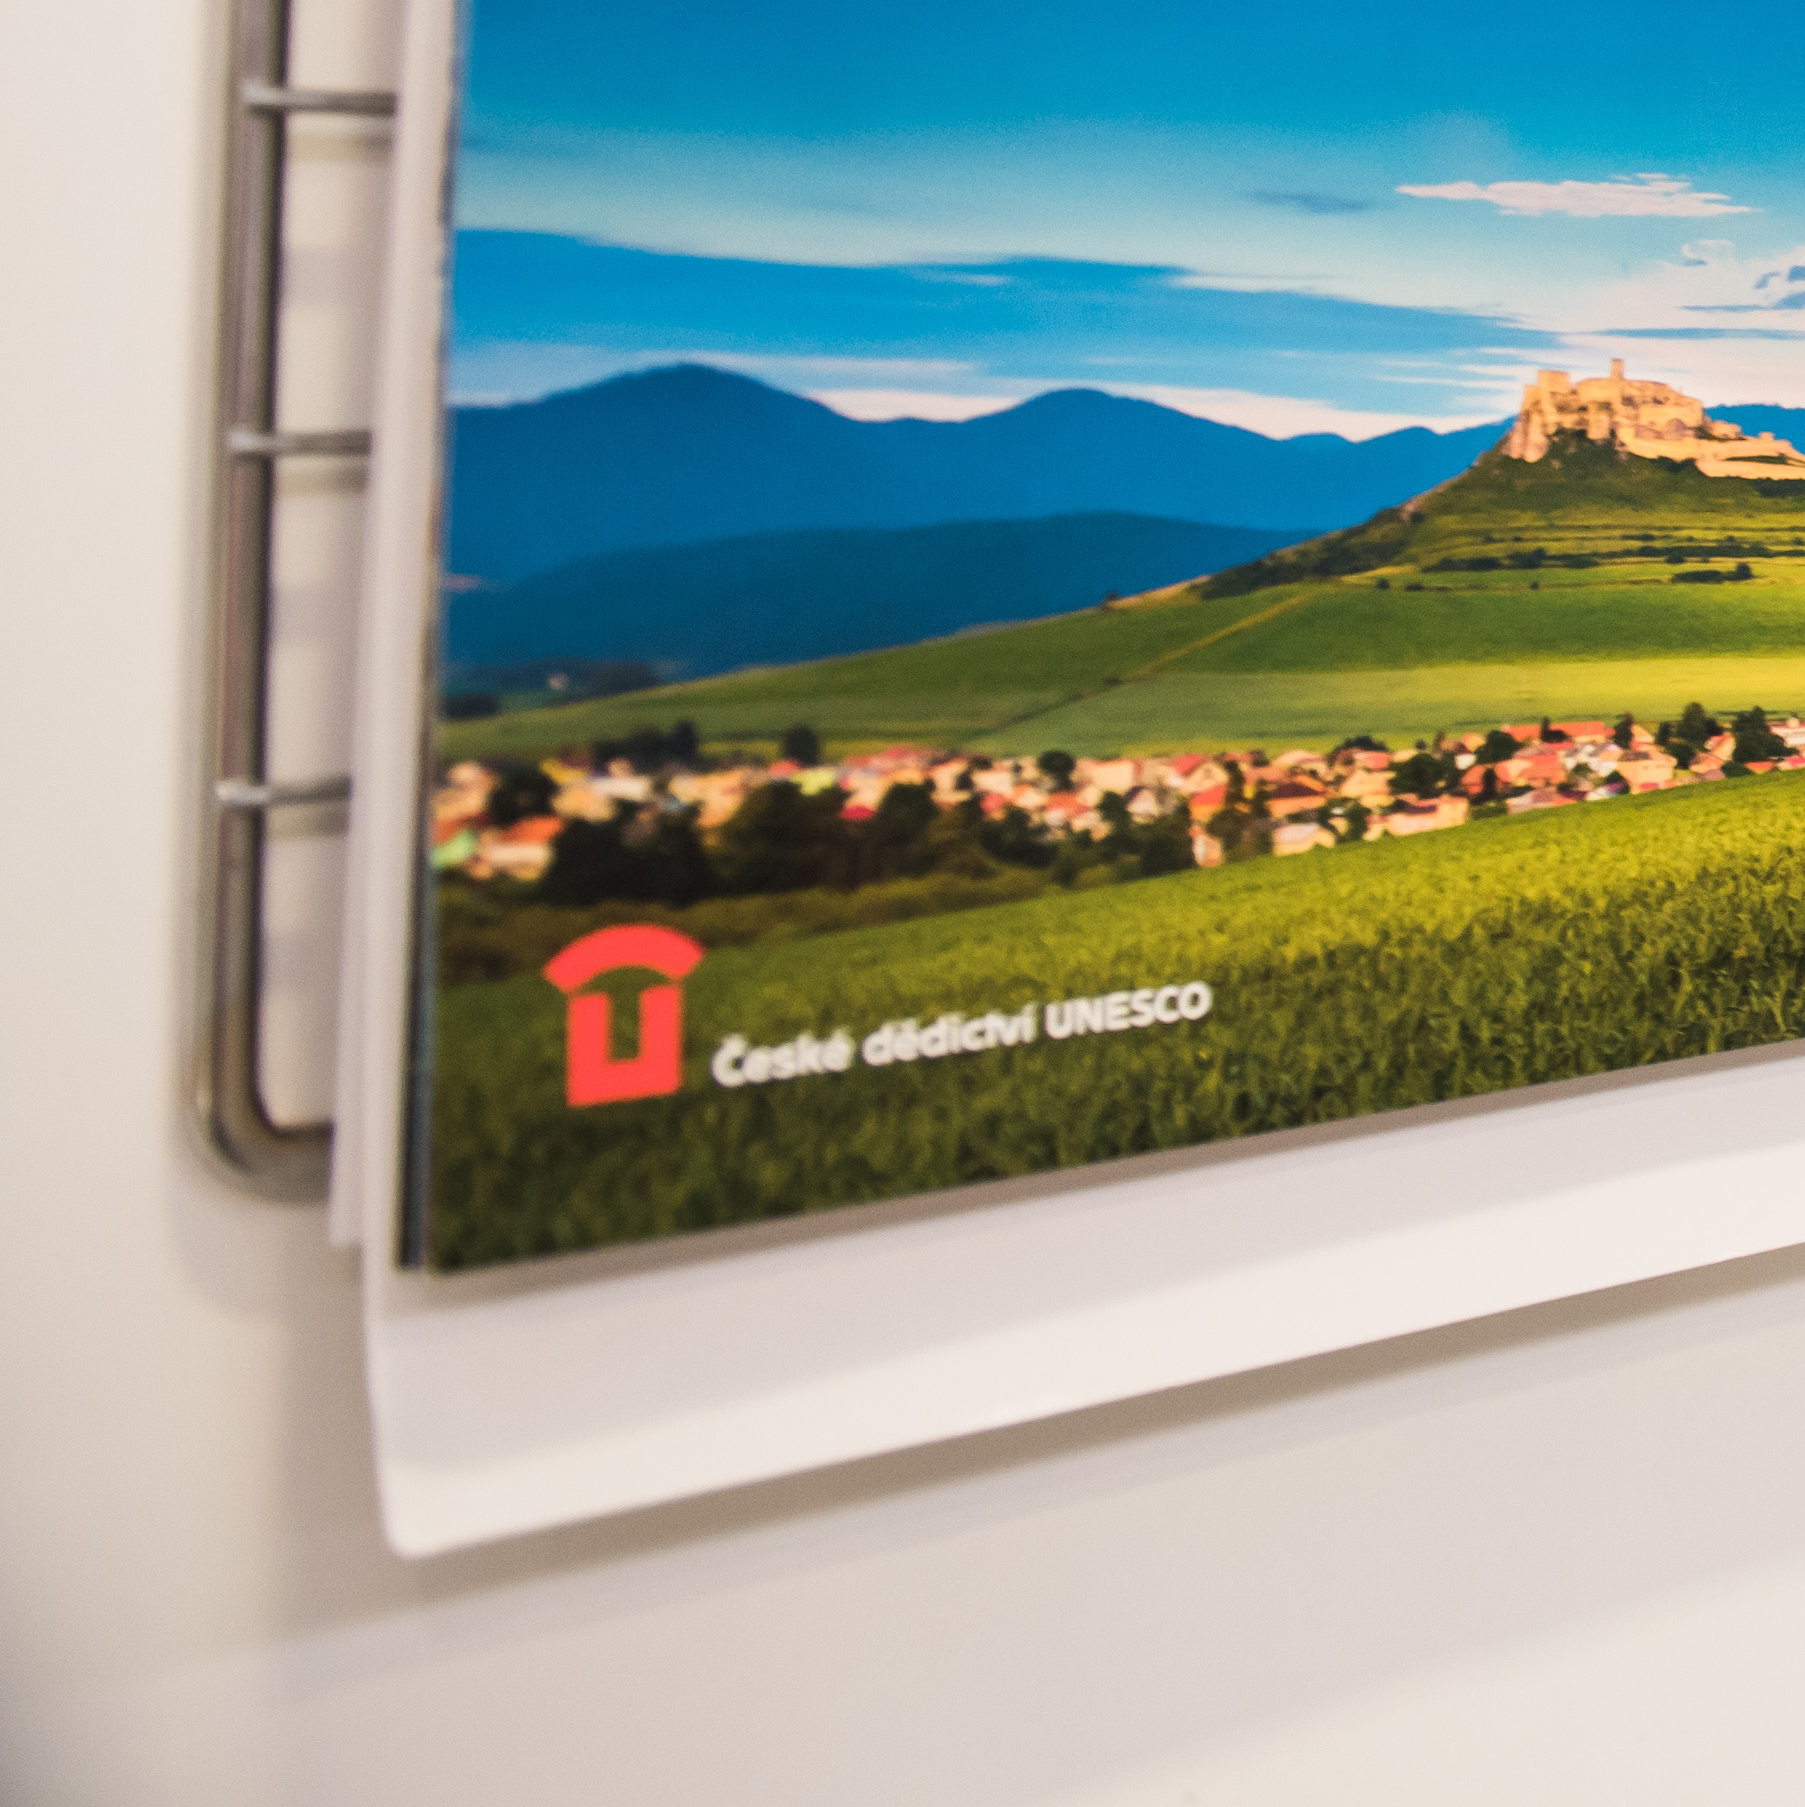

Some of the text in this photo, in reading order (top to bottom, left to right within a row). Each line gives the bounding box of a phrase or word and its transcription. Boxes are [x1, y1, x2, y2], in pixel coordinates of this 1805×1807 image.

[711, 981, 1213, 1088] České dědictví UNESCO
